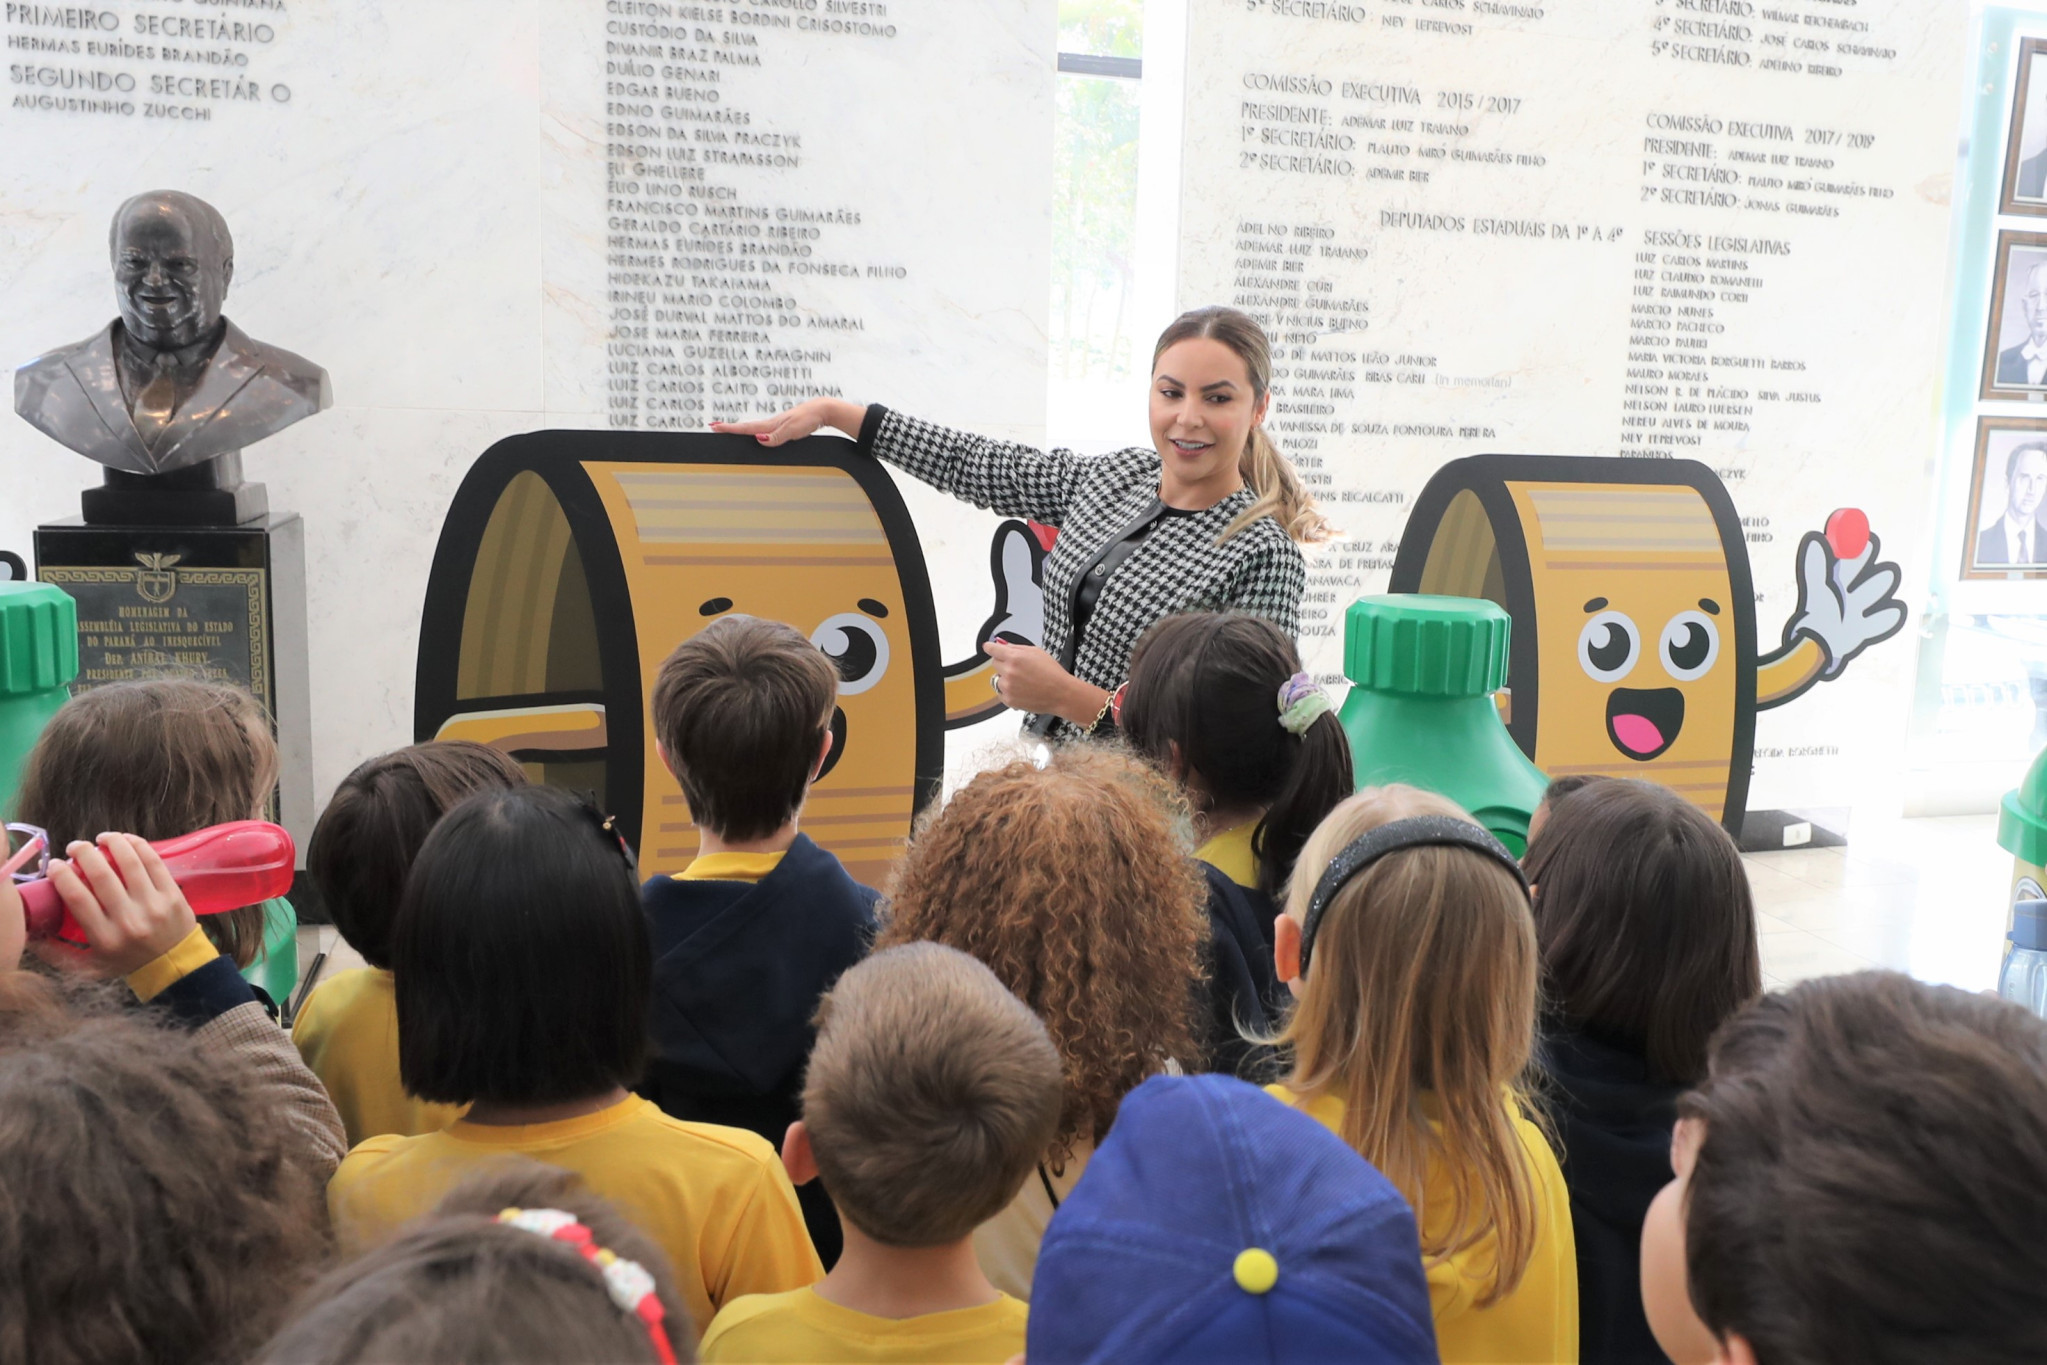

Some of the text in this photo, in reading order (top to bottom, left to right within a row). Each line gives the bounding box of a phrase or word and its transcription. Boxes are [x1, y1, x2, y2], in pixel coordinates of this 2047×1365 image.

[6, 4, 275, 43] PRIMEIRO SECRETÁRIO
[607, 1, 897, 37] CLEITON KIELSE BORDINI CRISOSTOMO
[607, 19, 758, 46] CUSTÓDIO DA SILVA
[8, 35, 248, 67] HERMAS EURÍDES BRANDÃO
[11, 64, 136, 92] SEGUNDO
[607, 60, 720, 82] DUÍLIO GENARI
[607, 82, 720, 102] EDGAR BUENO
[1243, 74, 1332, 97] COMISSÃO
[1342, 83, 1420, 105] EXECUTIVA
[12, 95, 211, 120] AUGUSTINHO ZUCCHI
[607, 103, 750, 124] EDNO GUIMARÃES
[1242, 102, 1468, 136] PRESIDENTE: ADEMAR LUIZ TRAIANO
[1646, 113, 1722, 134] COMISSÃO
[1728, 121, 1794, 142] EXECUTIVA
[607, 124, 802, 148] EDSON DA SILVA PRACZYK
[607, 144, 798, 168] EDSON LUIZ STRAPASSON
[1261, 128, 1356, 151] SECRETÁRIO:
[1368, 142, 1410, 156] PLAUTO
[1418, 144, 1446, 159] MIRÓ
[1451, 149, 1512, 164] GUIMARÃES
[1517, 153, 1546, 167] FILHO
[1644, 137, 1717, 159] PRESIDENTE:
[1728, 150, 1766, 164] ADEMAR
[1772, 153, 1789, 166] LUIZ
[633, 164, 704, 180] GHELLERE
[1260, 154, 1355, 178] SECRETÁRIO:
[1366, 167, 1404, 181] ADEMIR
[1410, 170, 1429, 183] BIER
[607, 200, 860, 224] FRANCISCO MARTINS GUIMARÃES
[608, 218, 820, 240] GERALDO CARTÁRIO RIBEIRO
[1381, 210, 1464, 231] DEPUTADOS
[1473, 218, 1545, 237] ESTADUAIS
[1552, 224, 1570, 240] DA
[1593, 226, 1602, 242] A
[608, 236, 812, 257] HERMAS EURÍDES BRANDÃO
[1236, 241, 1368, 260] ADEMAR LUIZ TRAIANO
[1644, 230, 1790, 256] SESSÕES LEGISLATIVAS
[608, 255, 907, 279] HERMES RODRIGUES DA FONSECA FILHO
[1235, 258, 1304, 273] ADEMIR BIER
[1636, 252, 1748, 271] LUIZ CARLOS MARTINS
[1234, 277, 1332, 293] ALEXANDRE CURI
[1634, 269, 1654, 281] LUIZ
[1661, 272, 1704, 284] CLAUDIO
[608, 291, 796, 310] IRINEU MARIO COLOMBO
[1633, 285, 1654, 297] LUIZ
[1661, 288, 1715, 302] RAIMUNDO
[1234, 295, 1368, 313] ALEXANDRE GUIMARÃES
[1632, 304, 1714, 318] MARCIO NUNES
[610, 305, 864, 330] JOSÉ DURVAL MATTOS DO AMARAL
[1630, 320, 1724, 334] MARCIO PACHECO
[1630, 336, 1670, 347] MARCIO
[608, 344, 831, 362] LUCIANA GUZELLA RAFAGNIN
[608, 363, 812, 378] LUIZ CARLOS ALBORGHETTI
[1626, 368, 1708, 382] MAURO MORAES
[608, 380, 843, 397] LUIZ CARLOS CAITO QUINTANA
[1276, 403, 1334, 416] BRASILEIRO
[1624, 400, 1753, 416] NELSON LAURO LUERSEN
[1622, 417, 1750, 432] NEREU ALVES DE MOURA
[1282, 438, 1318, 450] PALOZI
[1621, 432, 1701, 446] NEY LEPREVOST
[119, 606, 188, 618] HOMENAGEM DA
[130, 622, 181, 632] LEGISLATIVA
[187, 622, 198, 632] DO
[204, 622, 234, 632] ESTADO
[87, 636, 98, 647] DO
[104, 634, 136, 647] PARANÁ
[144, 636, 155, 647] AO
